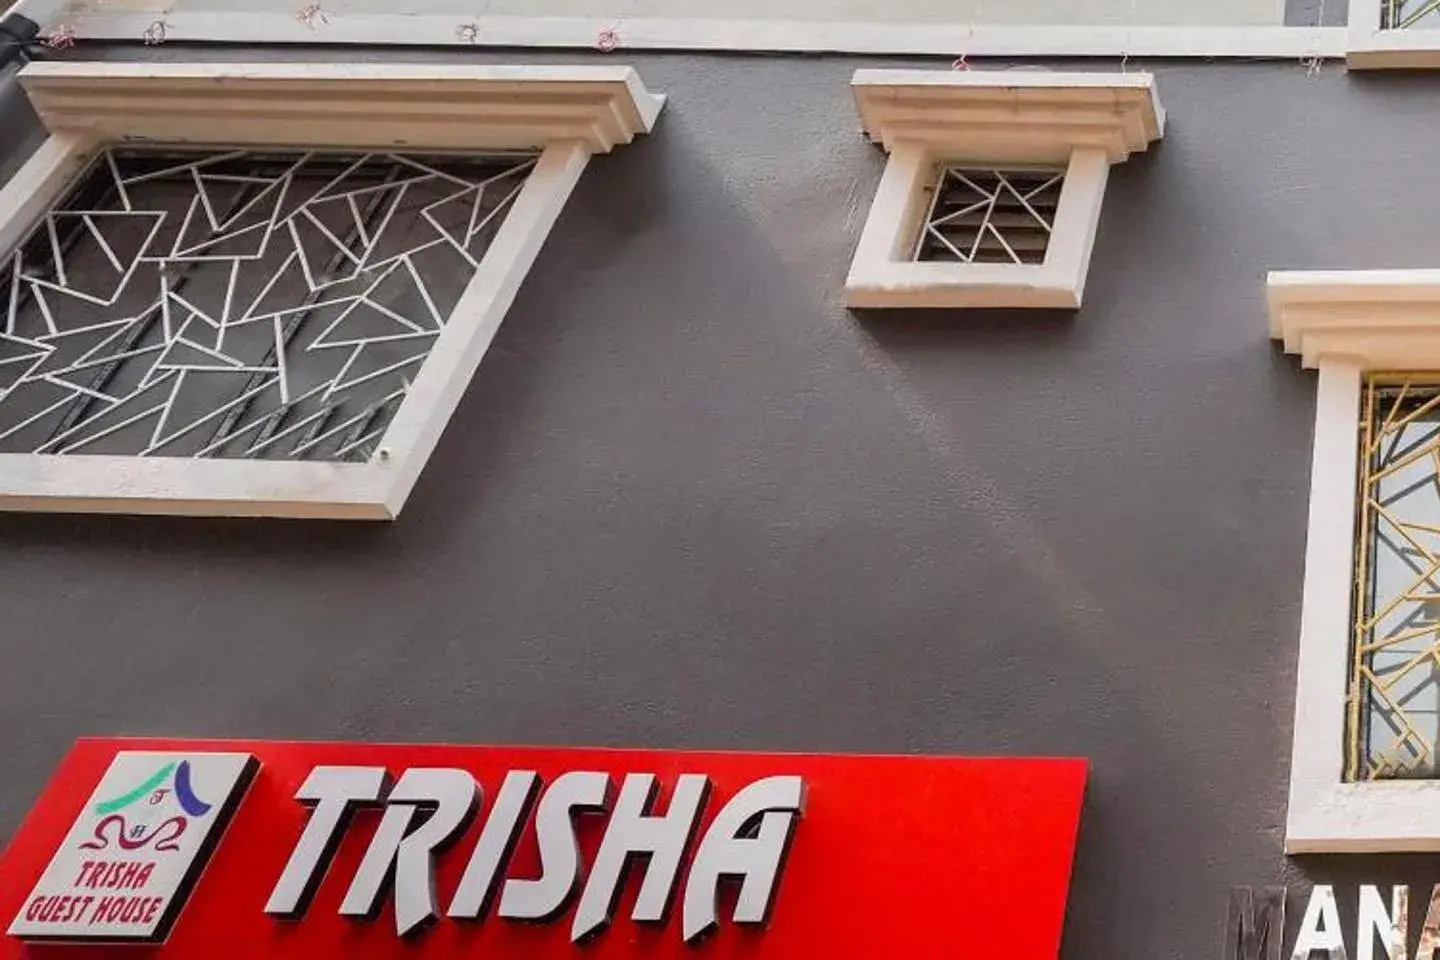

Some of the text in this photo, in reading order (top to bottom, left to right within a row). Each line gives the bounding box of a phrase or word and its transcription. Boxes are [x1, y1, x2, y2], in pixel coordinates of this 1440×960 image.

[263, 766, 804, 942] TRISHA
[74, 861, 156, 889] TRISHA
[25, 895, 164, 926] GUEST HOUSE
